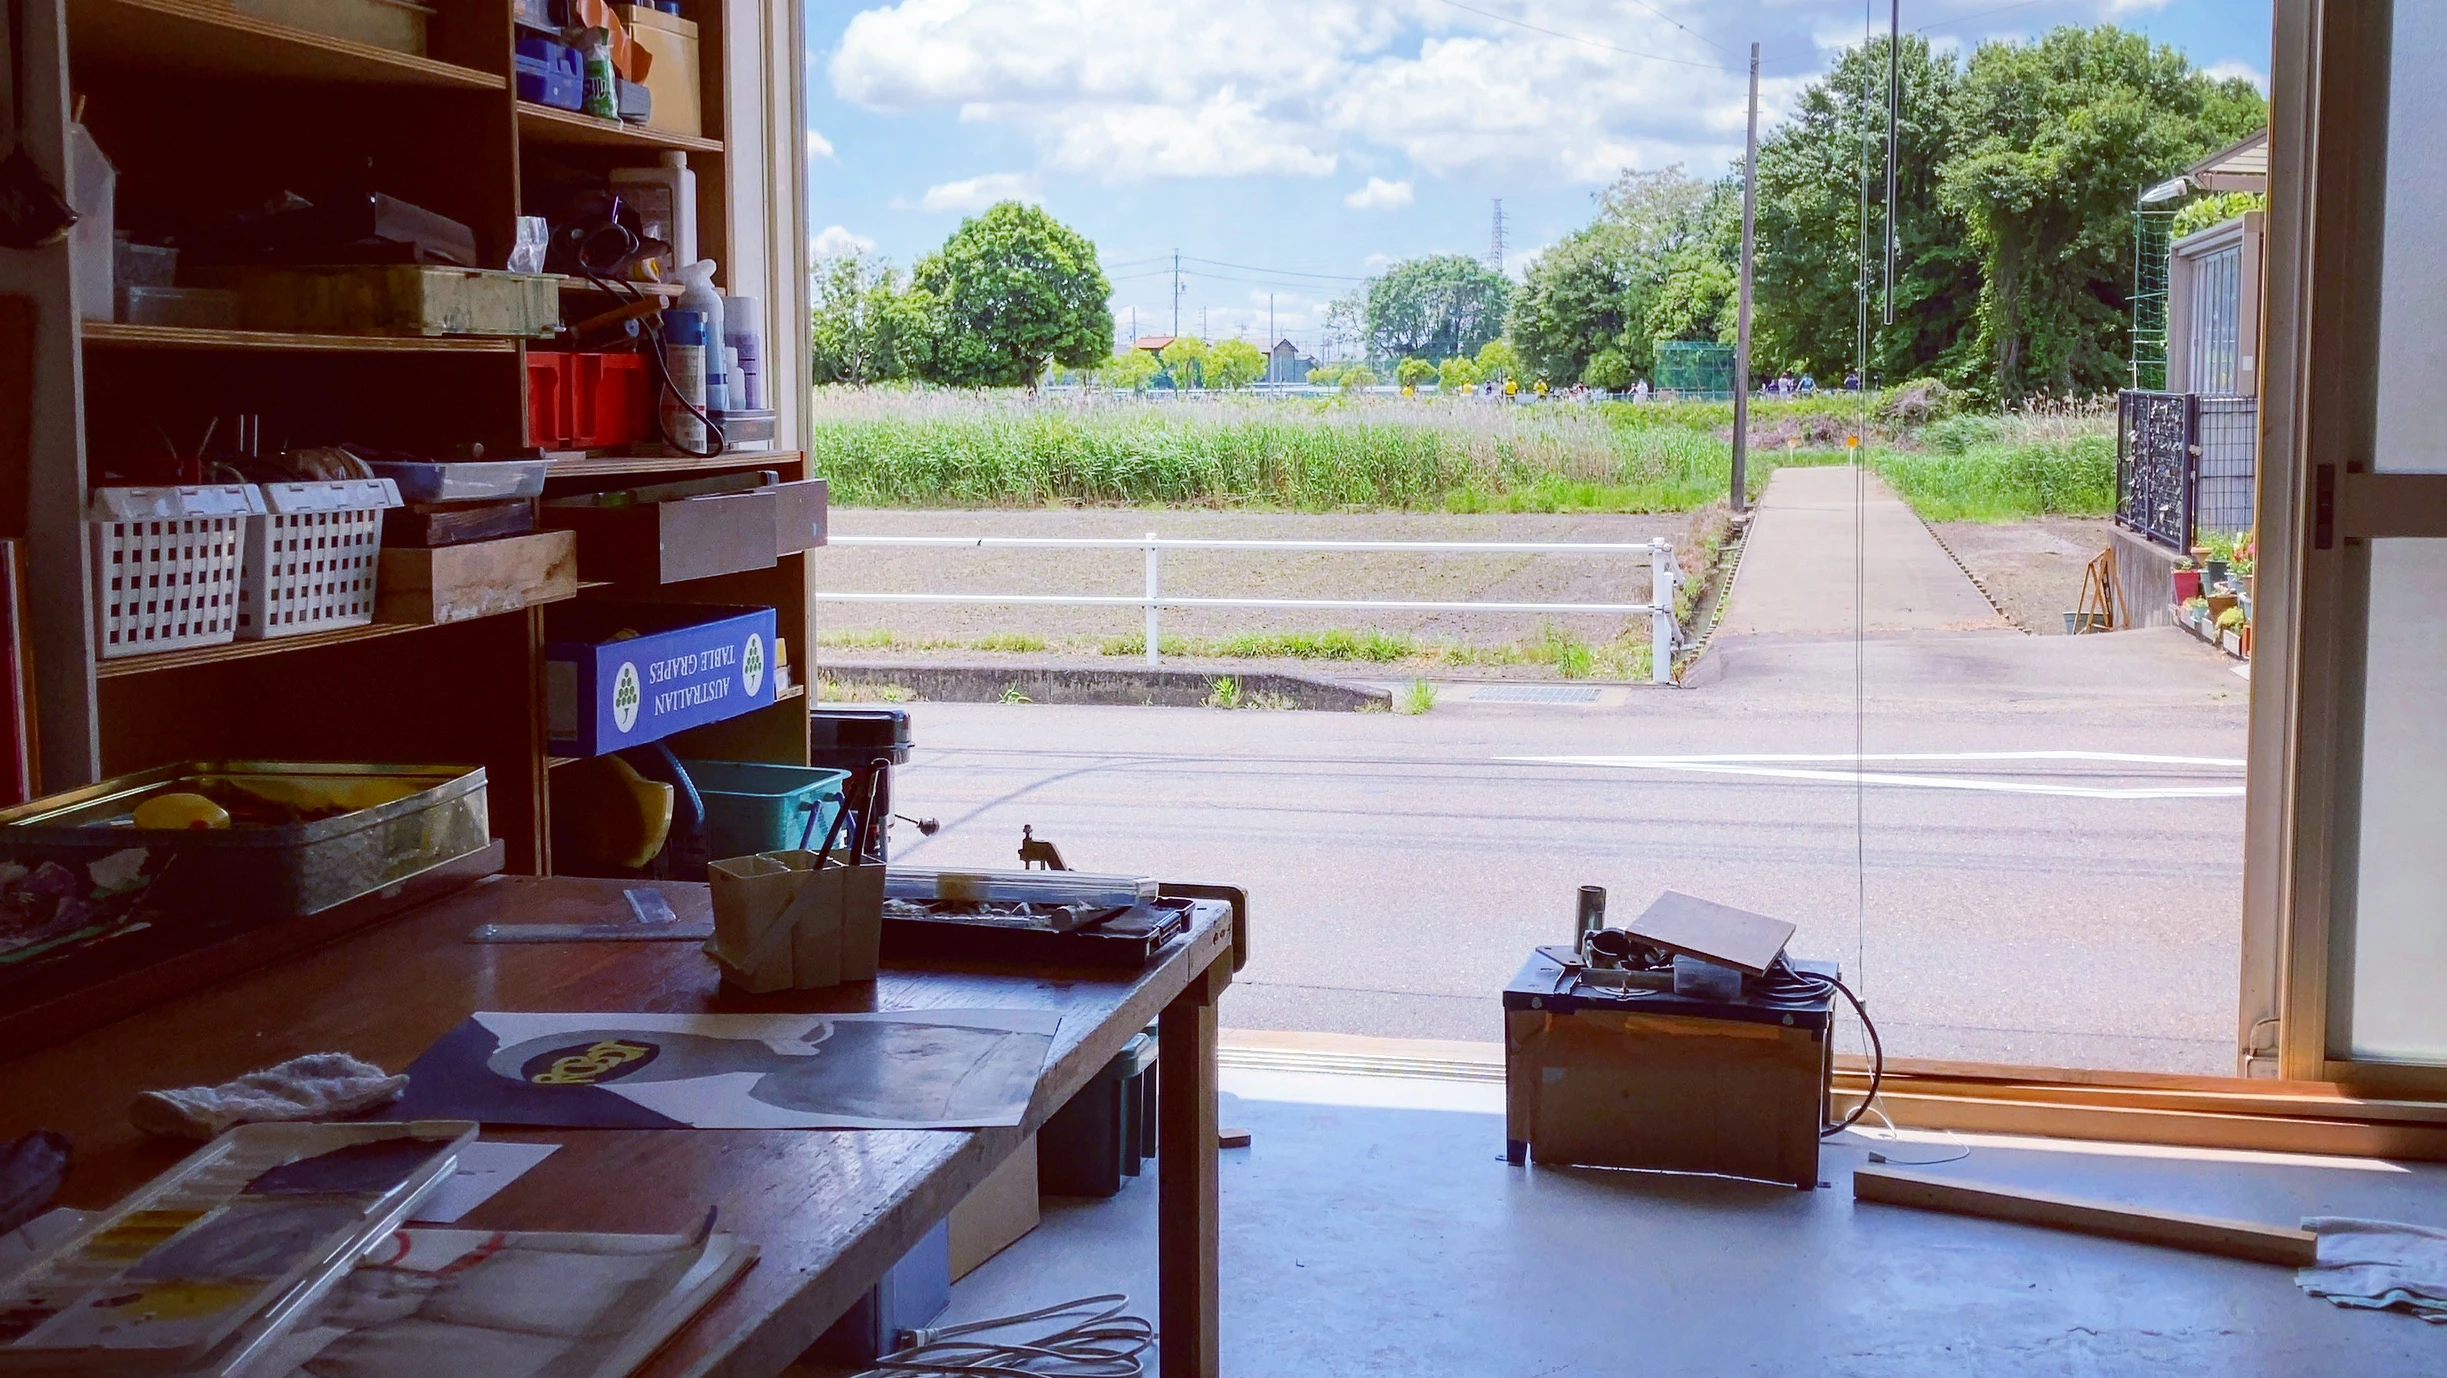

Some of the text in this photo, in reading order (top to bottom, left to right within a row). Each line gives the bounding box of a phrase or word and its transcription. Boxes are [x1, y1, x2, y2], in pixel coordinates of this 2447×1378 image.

[649, 645, 736, 685] TABLE GRAPES
[654, 676, 730, 716] AUSTRALIAN
